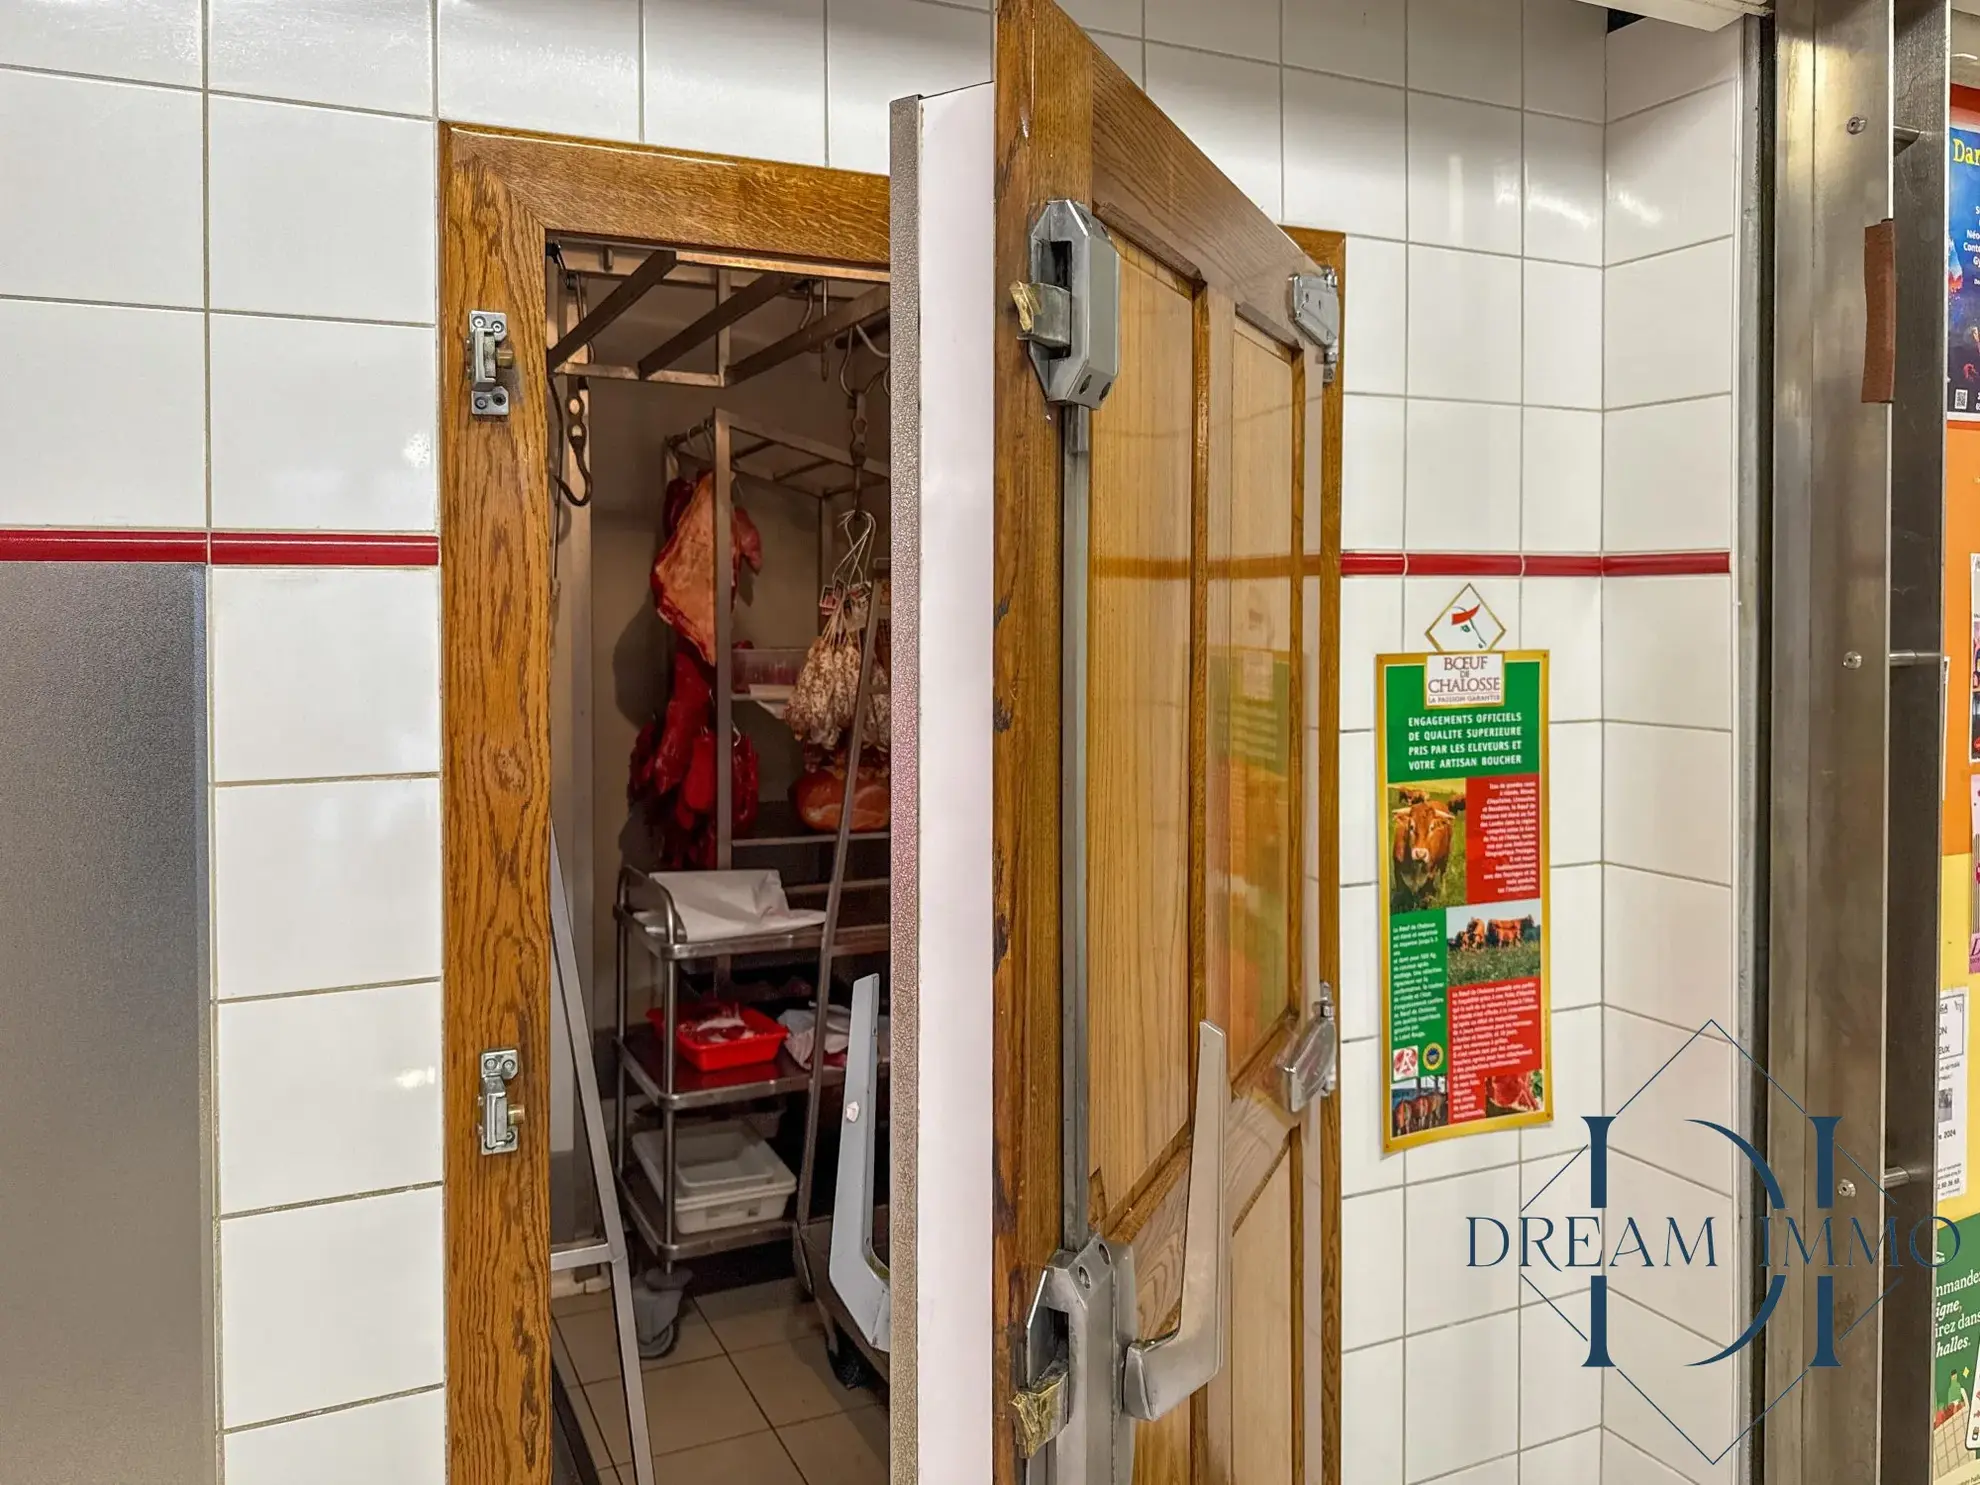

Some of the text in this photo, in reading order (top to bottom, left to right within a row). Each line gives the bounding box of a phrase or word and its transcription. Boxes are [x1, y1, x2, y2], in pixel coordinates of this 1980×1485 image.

[1444, 656, 1488, 671] BŒUF
[1459, 670, 1470, 678] DE
[1428, 677, 1500, 693] CHALOSSE
[1408, 712, 1522, 727] ENGAGEMENTS OFFICIELS
[1408, 726, 1522, 741] DE QUALITE SUPERIEURE
[1408, 740, 1522, 756] PRIS PAR LES ELEVEURS ET
[1408, 754, 1522, 771] VOTRE ARTISAN BOUCHER
[1936, 1335, 1971, 1358] halles.
